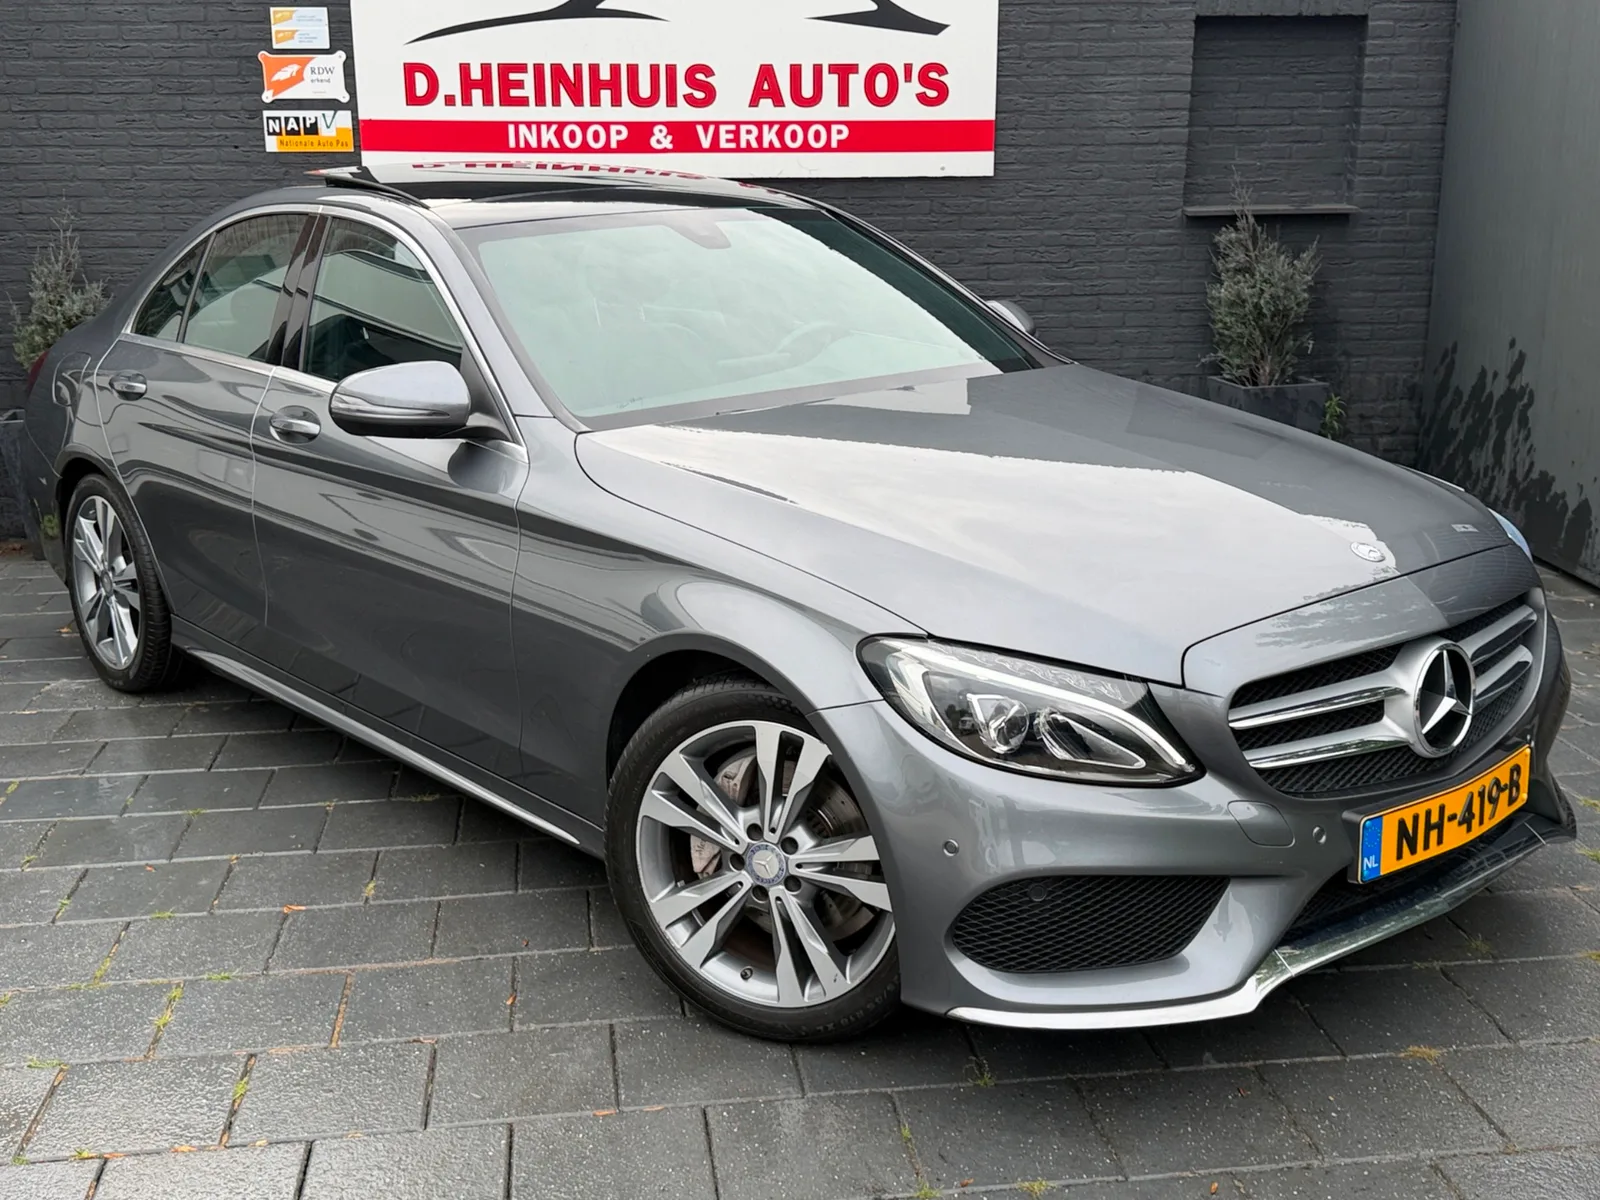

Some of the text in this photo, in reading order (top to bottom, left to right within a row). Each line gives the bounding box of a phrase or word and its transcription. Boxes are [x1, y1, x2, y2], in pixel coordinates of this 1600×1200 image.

[310, 66, 335, 75] RDW
[403, 62, 950, 108] D.HEINHUIS AUTO'S
[280, 139, 349, 148] Nationale Auto Pas
[507, 124, 850, 150] INKOOP & VERKOOP
[1363, 763, 1522, 870] NL NH-419-B
